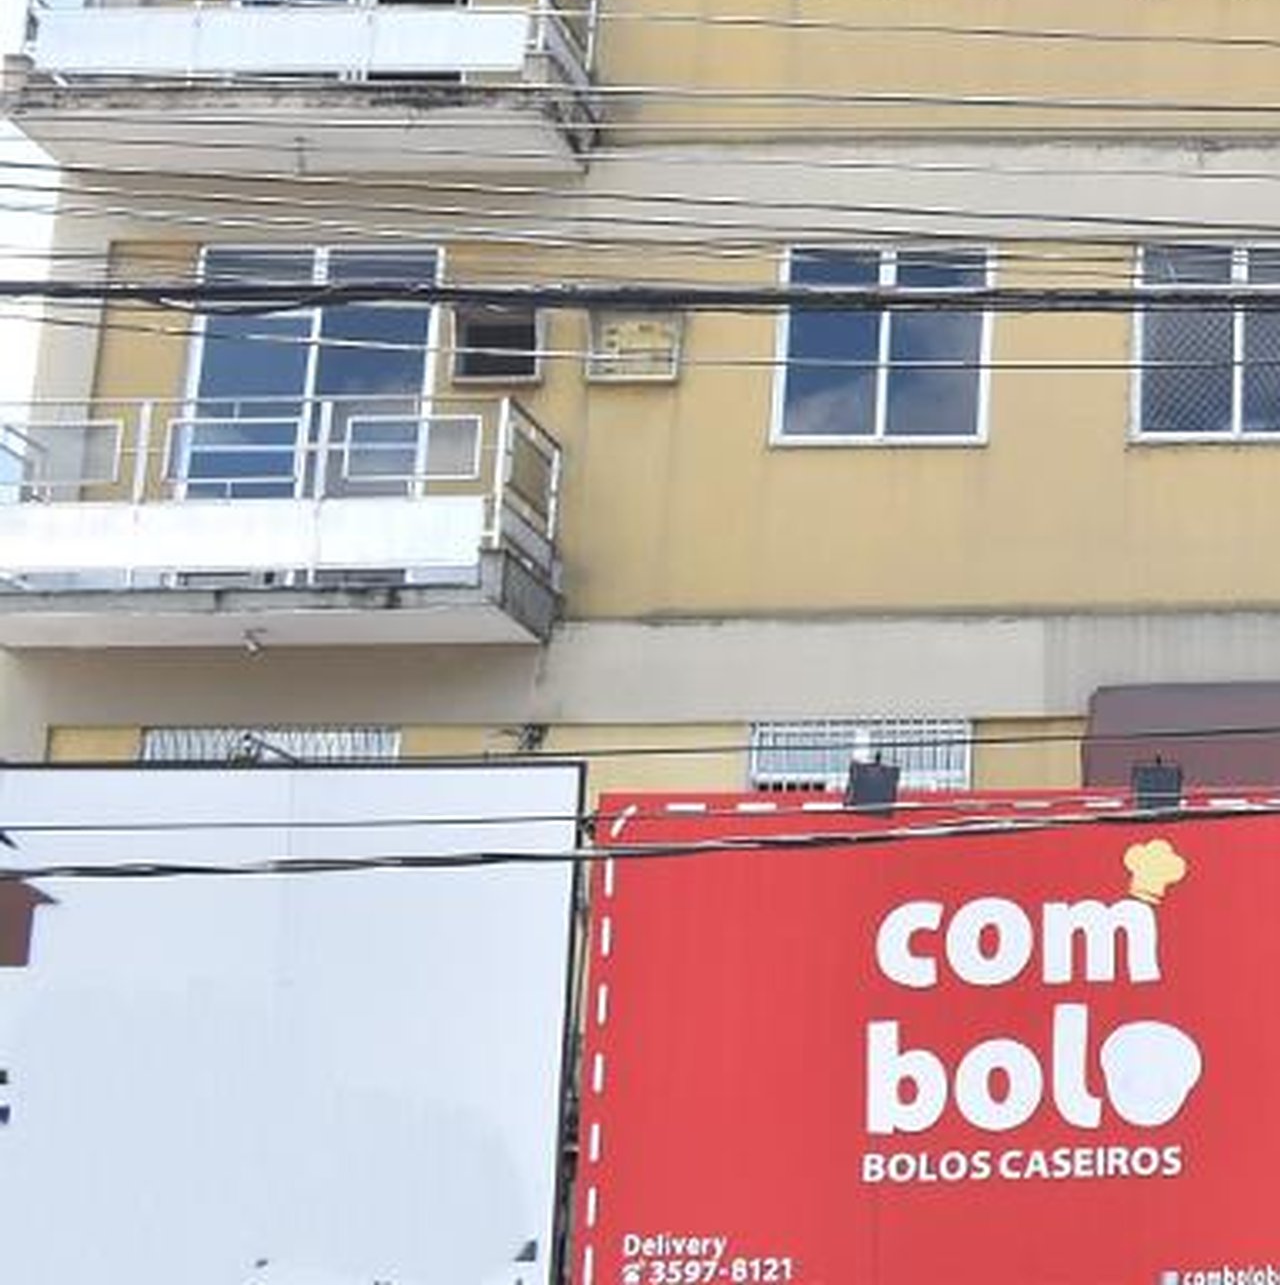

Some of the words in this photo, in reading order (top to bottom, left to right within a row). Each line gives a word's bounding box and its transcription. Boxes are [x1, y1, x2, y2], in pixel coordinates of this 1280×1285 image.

[876, 896, 1160, 987] com
[865, 1003, 1202, 1134] bolo
[862, 1151, 992, 1183] BOLOS
[998, 1146, 1183, 1179] CASEIROS
[623, 1233, 728, 1259] Delivery
[649, 1257, 793, 1283] 3597-8121
